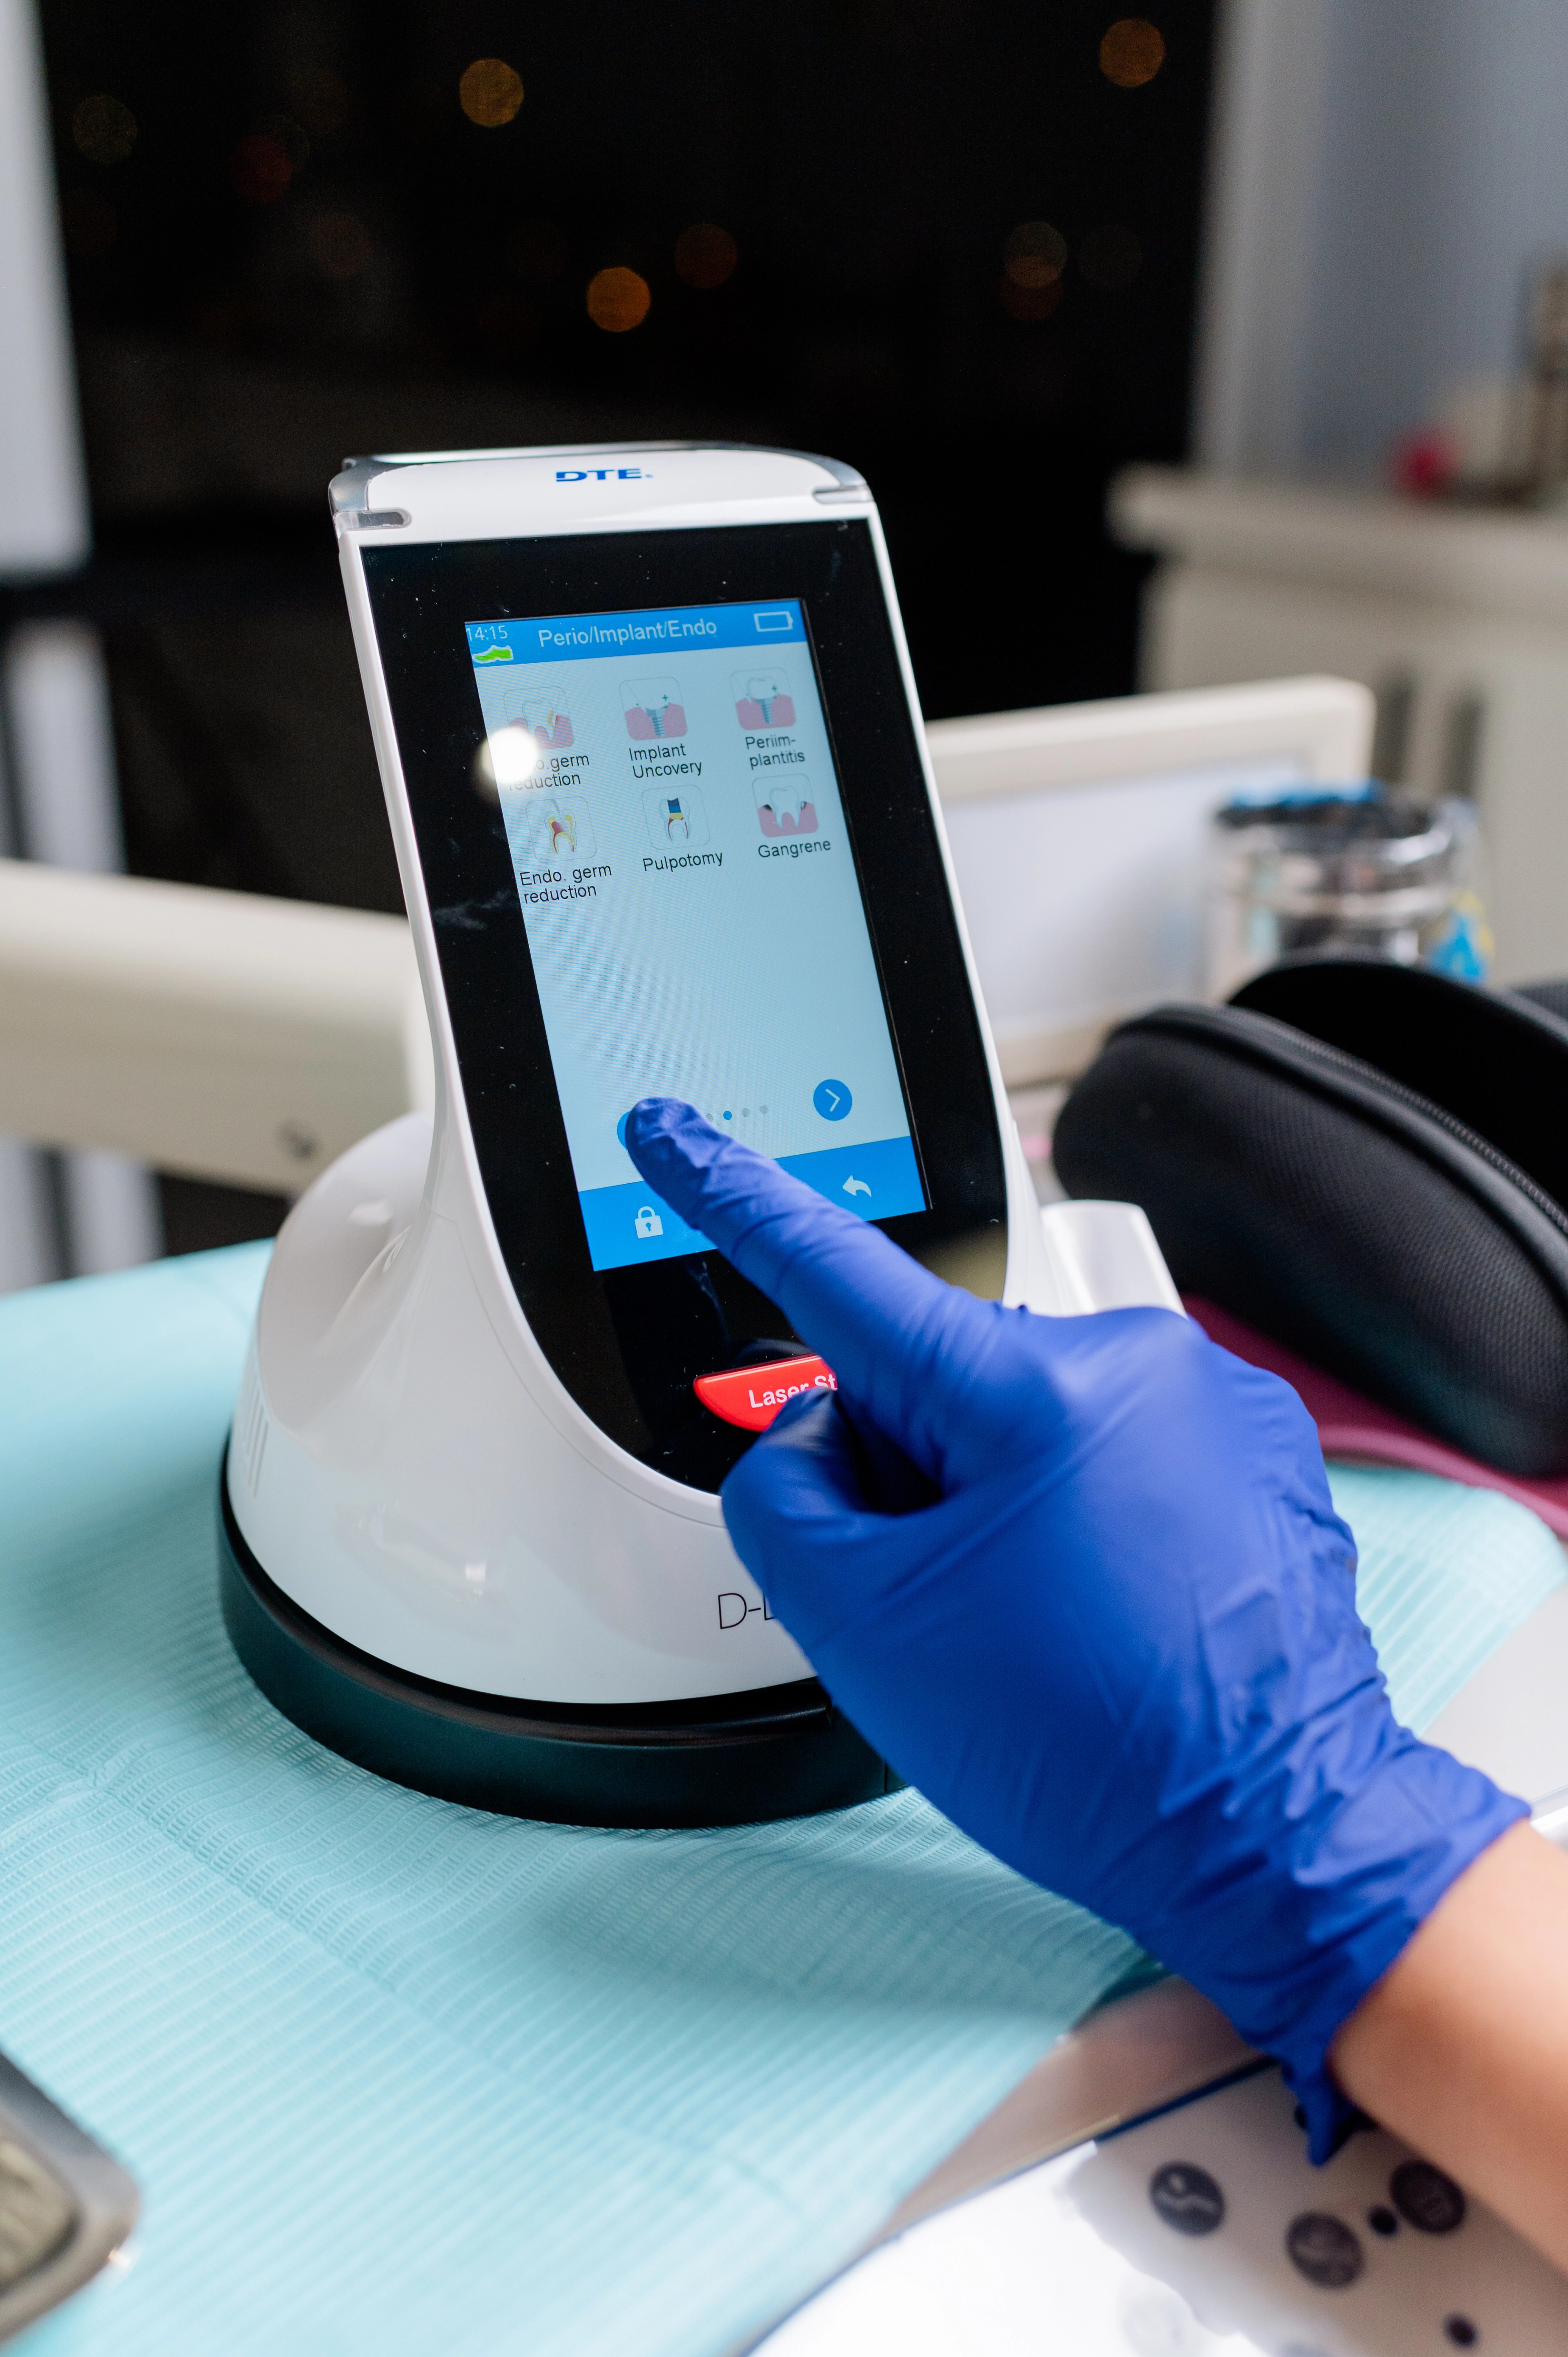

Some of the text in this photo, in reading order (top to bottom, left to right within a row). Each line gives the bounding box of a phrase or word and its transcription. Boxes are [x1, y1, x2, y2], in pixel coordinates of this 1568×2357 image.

[556, 468, 641, 482] DTE
[466, 625, 508, 641] 14:15
[538, 618, 717, 647] Perio/Implant/Endo
[745, 734, 796, 749] Periim-
[629, 743, 686, 763] Implant
[749, 749, 805, 770] plantitis
[532, 755, 590, 772] o.germ
[633, 762, 702, 778] Uncovery
[758, 840, 831, 858] Gangrene
[642, 852, 723, 872] Pulpotomy
[520, 865, 612, 886] Endo. germ
[524, 885, 597, 904] reduction
